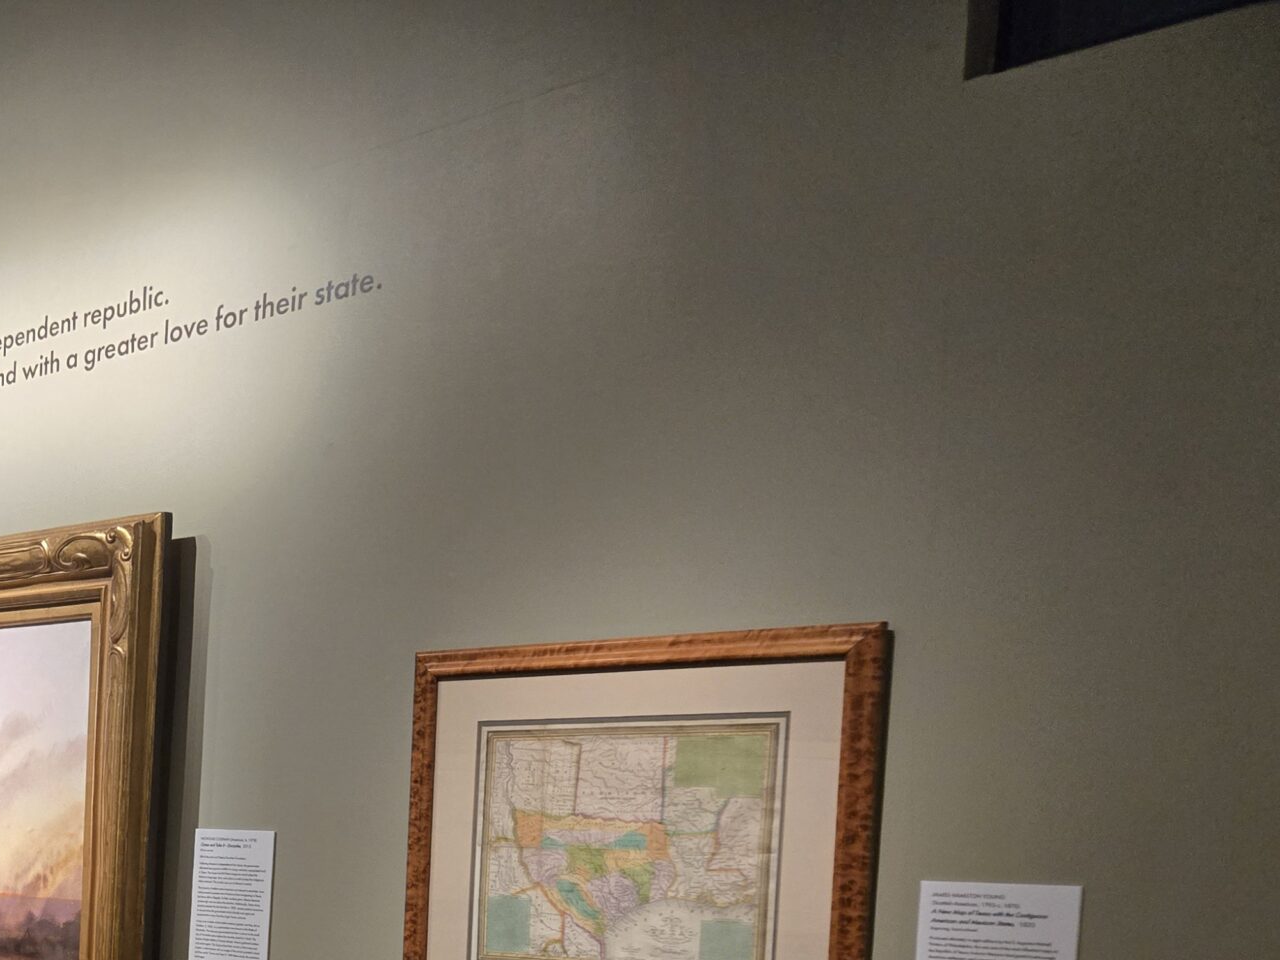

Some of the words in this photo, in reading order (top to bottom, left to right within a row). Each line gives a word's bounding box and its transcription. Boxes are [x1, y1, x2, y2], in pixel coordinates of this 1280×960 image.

[22, 350, 60, 380] with
[66, 353, 78, 369] a
[84, 331, 158, 371] greater
[164, 318, 208, 345] love
[215, 304, 248, 331] for
[254, 286, 308, 321] their
[314, 273, 382, 306] state.
[83, 286, 169, 329] republic.
